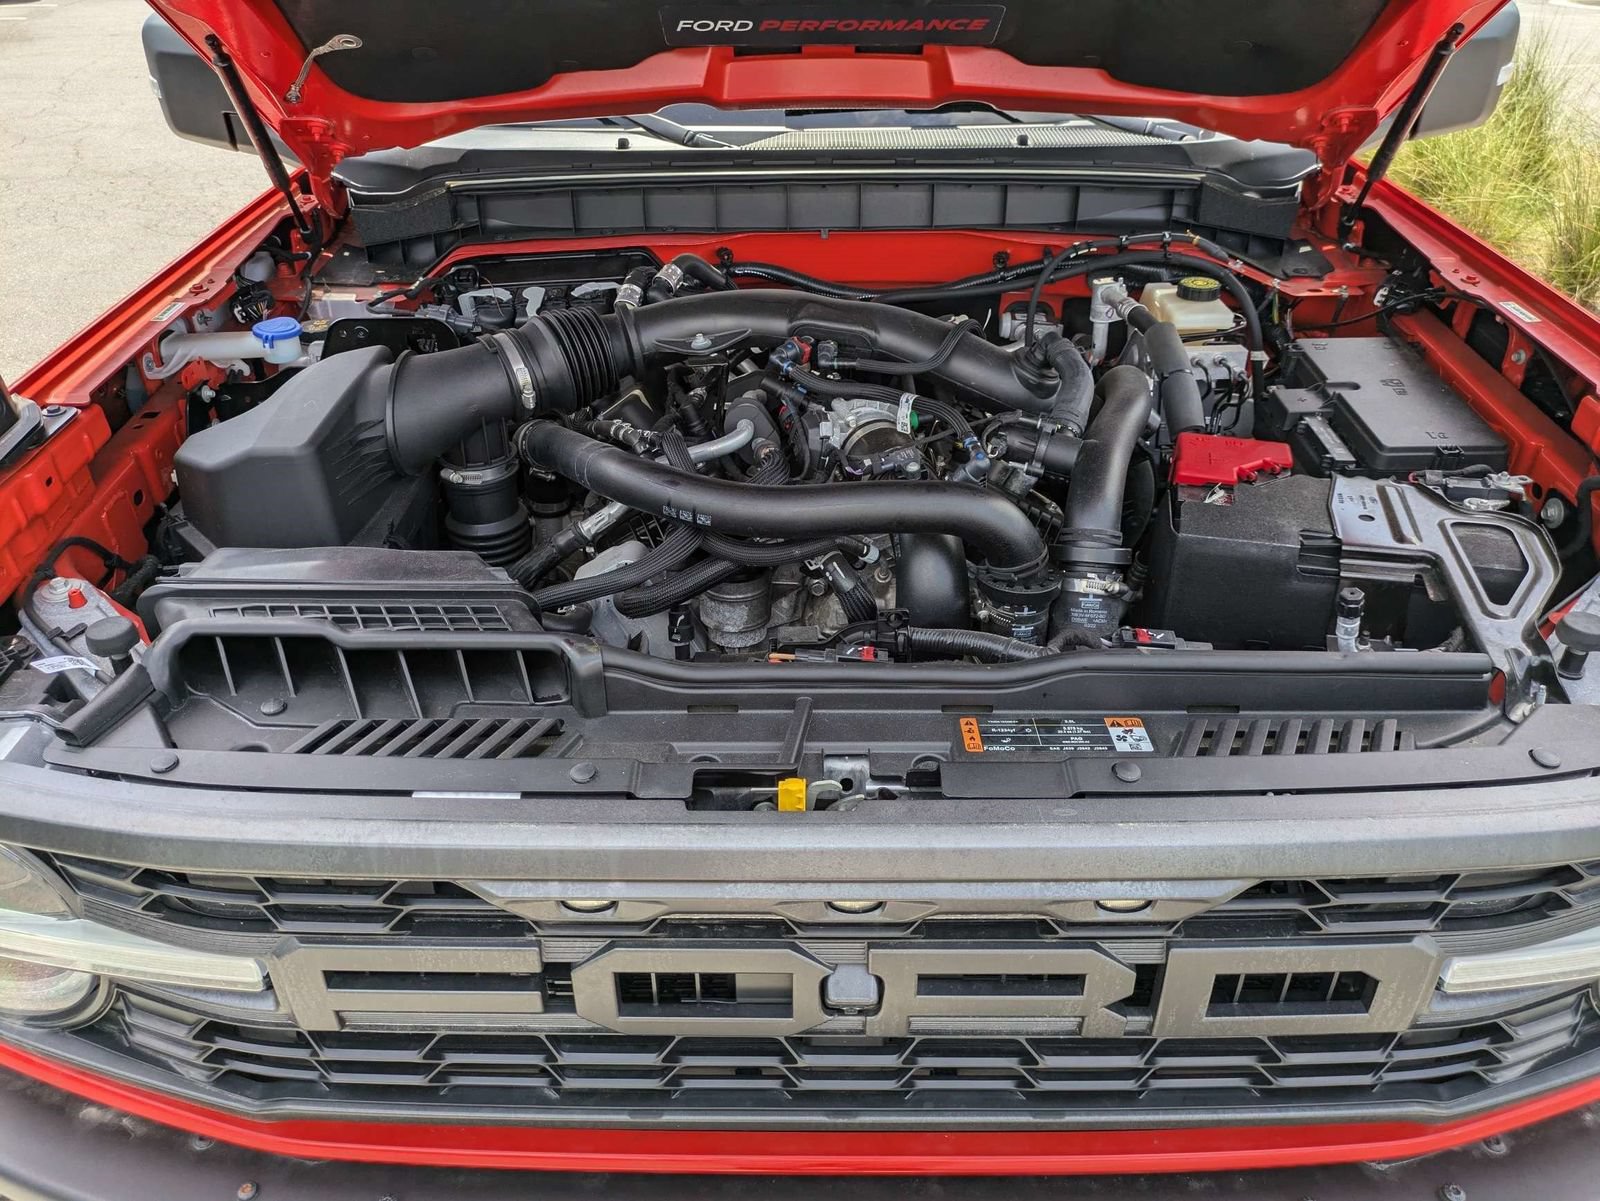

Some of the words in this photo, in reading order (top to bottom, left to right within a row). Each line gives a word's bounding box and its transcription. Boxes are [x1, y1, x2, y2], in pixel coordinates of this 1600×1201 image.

[676, 20, 753, 32] FORD
[758, 18, 991, 32] PERFORMANCE
[270, 936, 1442, 1039] FORD
